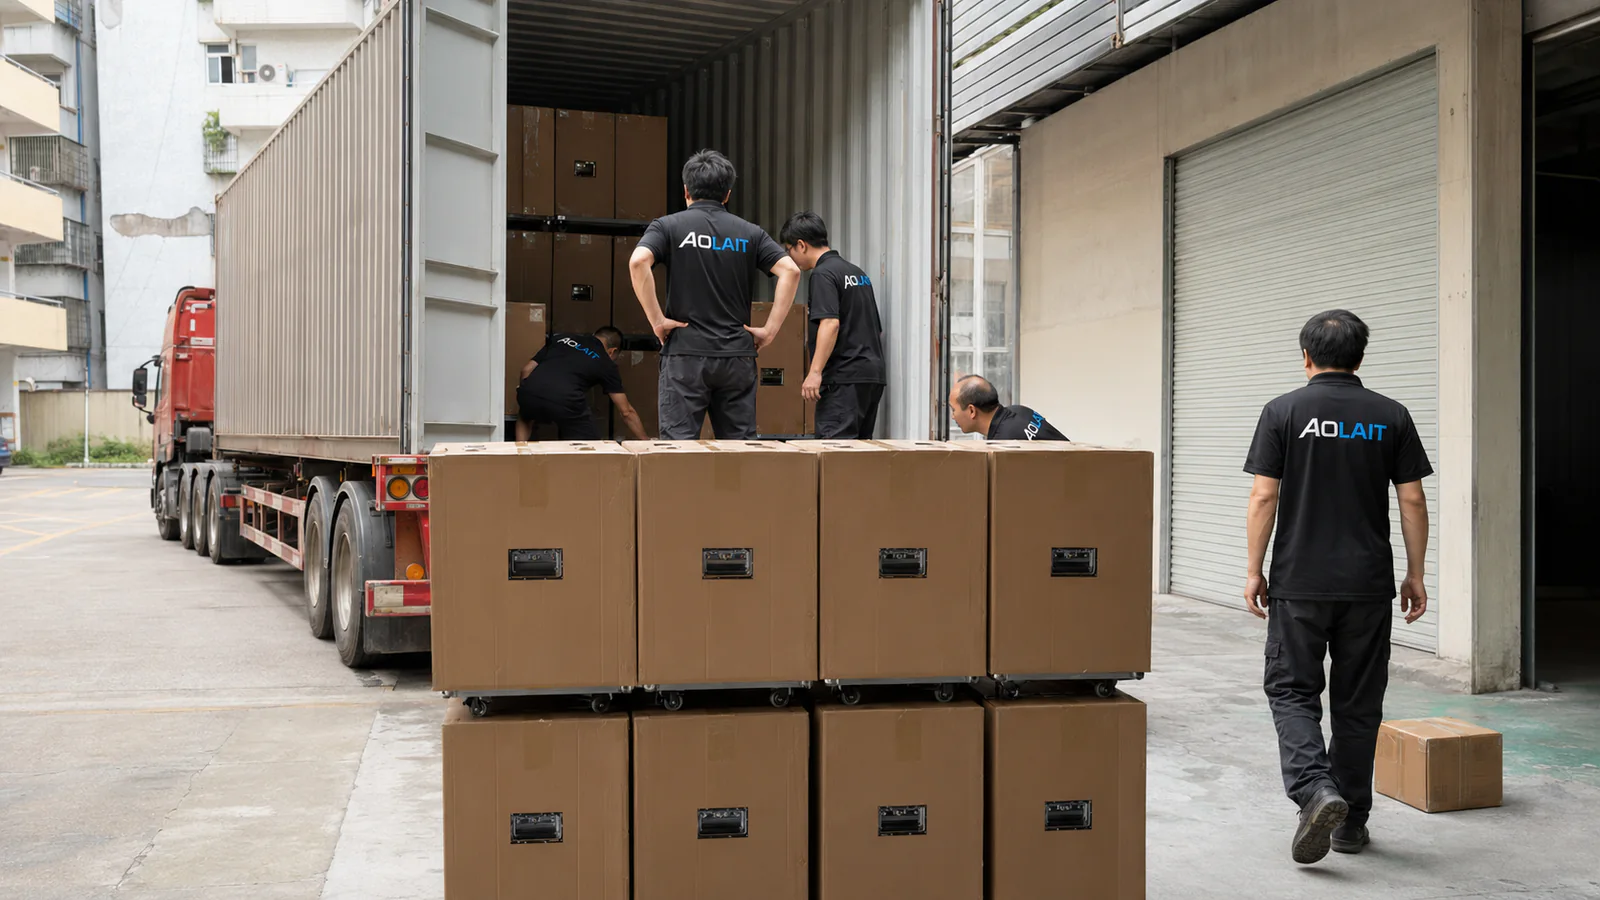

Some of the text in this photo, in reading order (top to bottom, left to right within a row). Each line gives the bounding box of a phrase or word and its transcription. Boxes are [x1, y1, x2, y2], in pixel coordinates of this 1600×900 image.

[679, 231, 749, 253] AOLAIT
[1024, 411, 1044, 440] AOLA
[1298, 417, 1387, 441] AOLAIT
